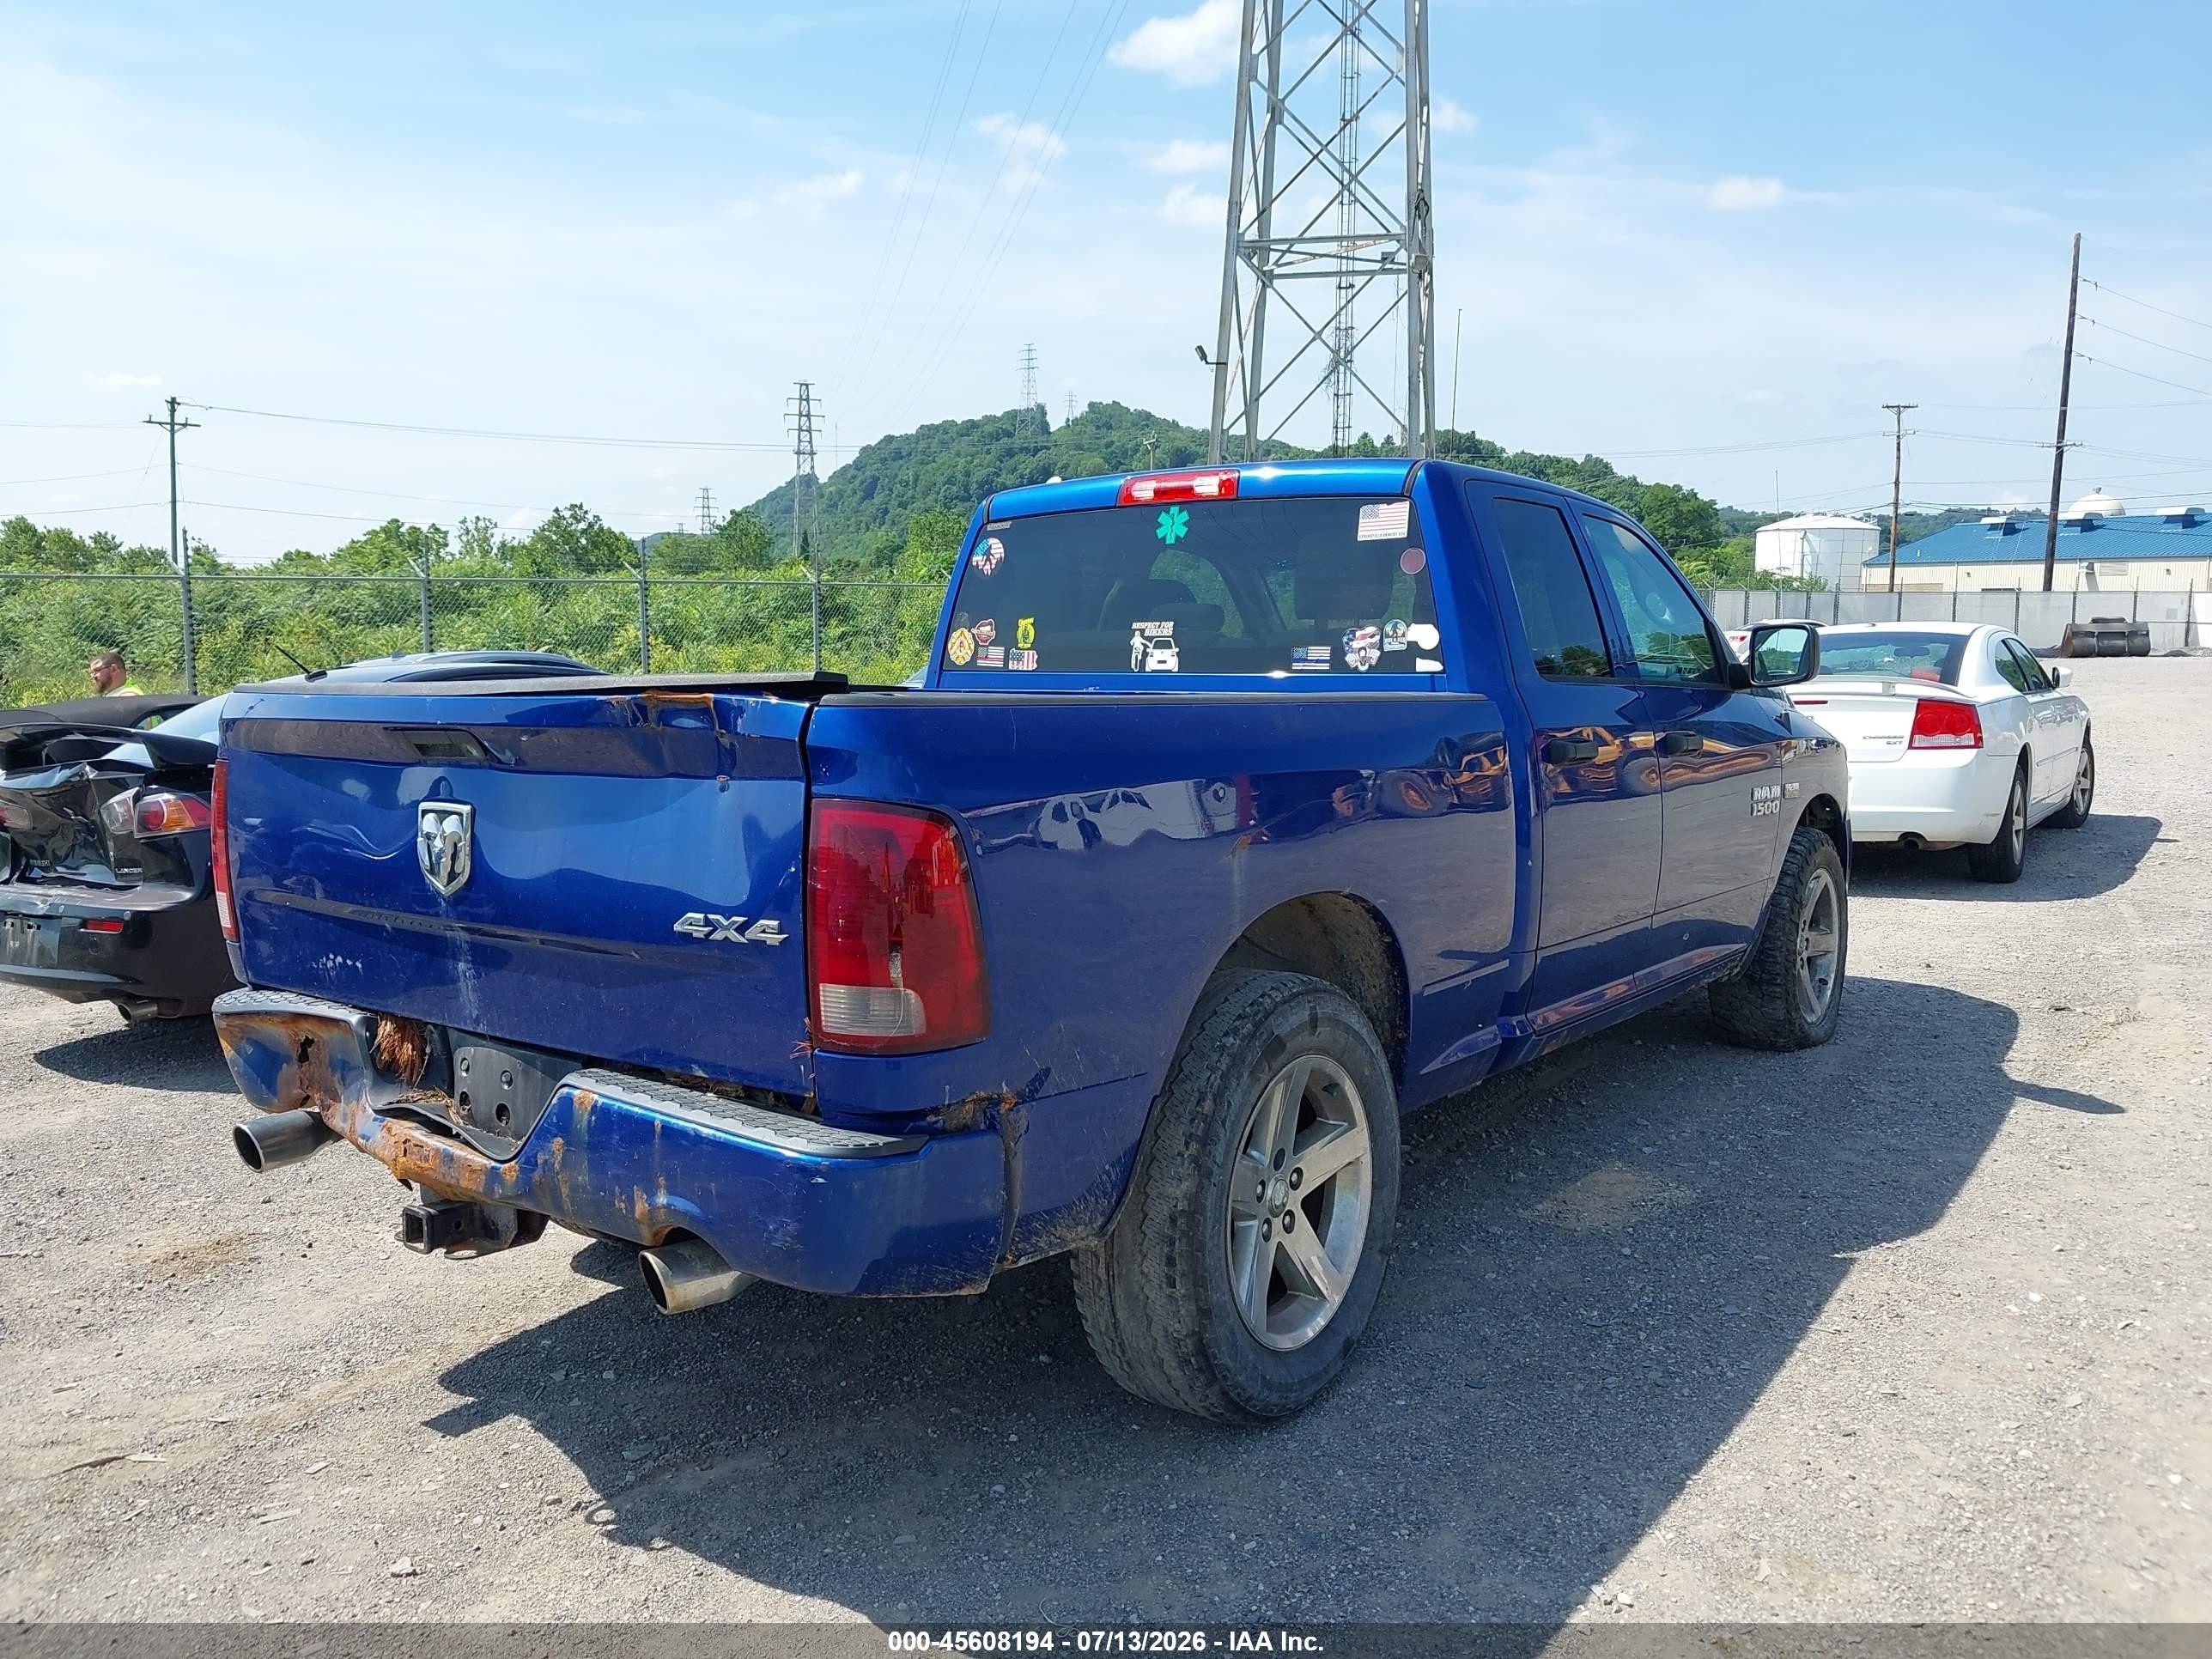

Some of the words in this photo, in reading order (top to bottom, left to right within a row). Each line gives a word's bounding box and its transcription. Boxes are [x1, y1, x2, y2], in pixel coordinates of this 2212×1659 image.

[1144, 628, 1174, 636] BIKERS
[1753, 785, 1781, 800] RAM
[1752, 799, 1780, 817] 1500
[673, 912, 790, 945] 4X4
